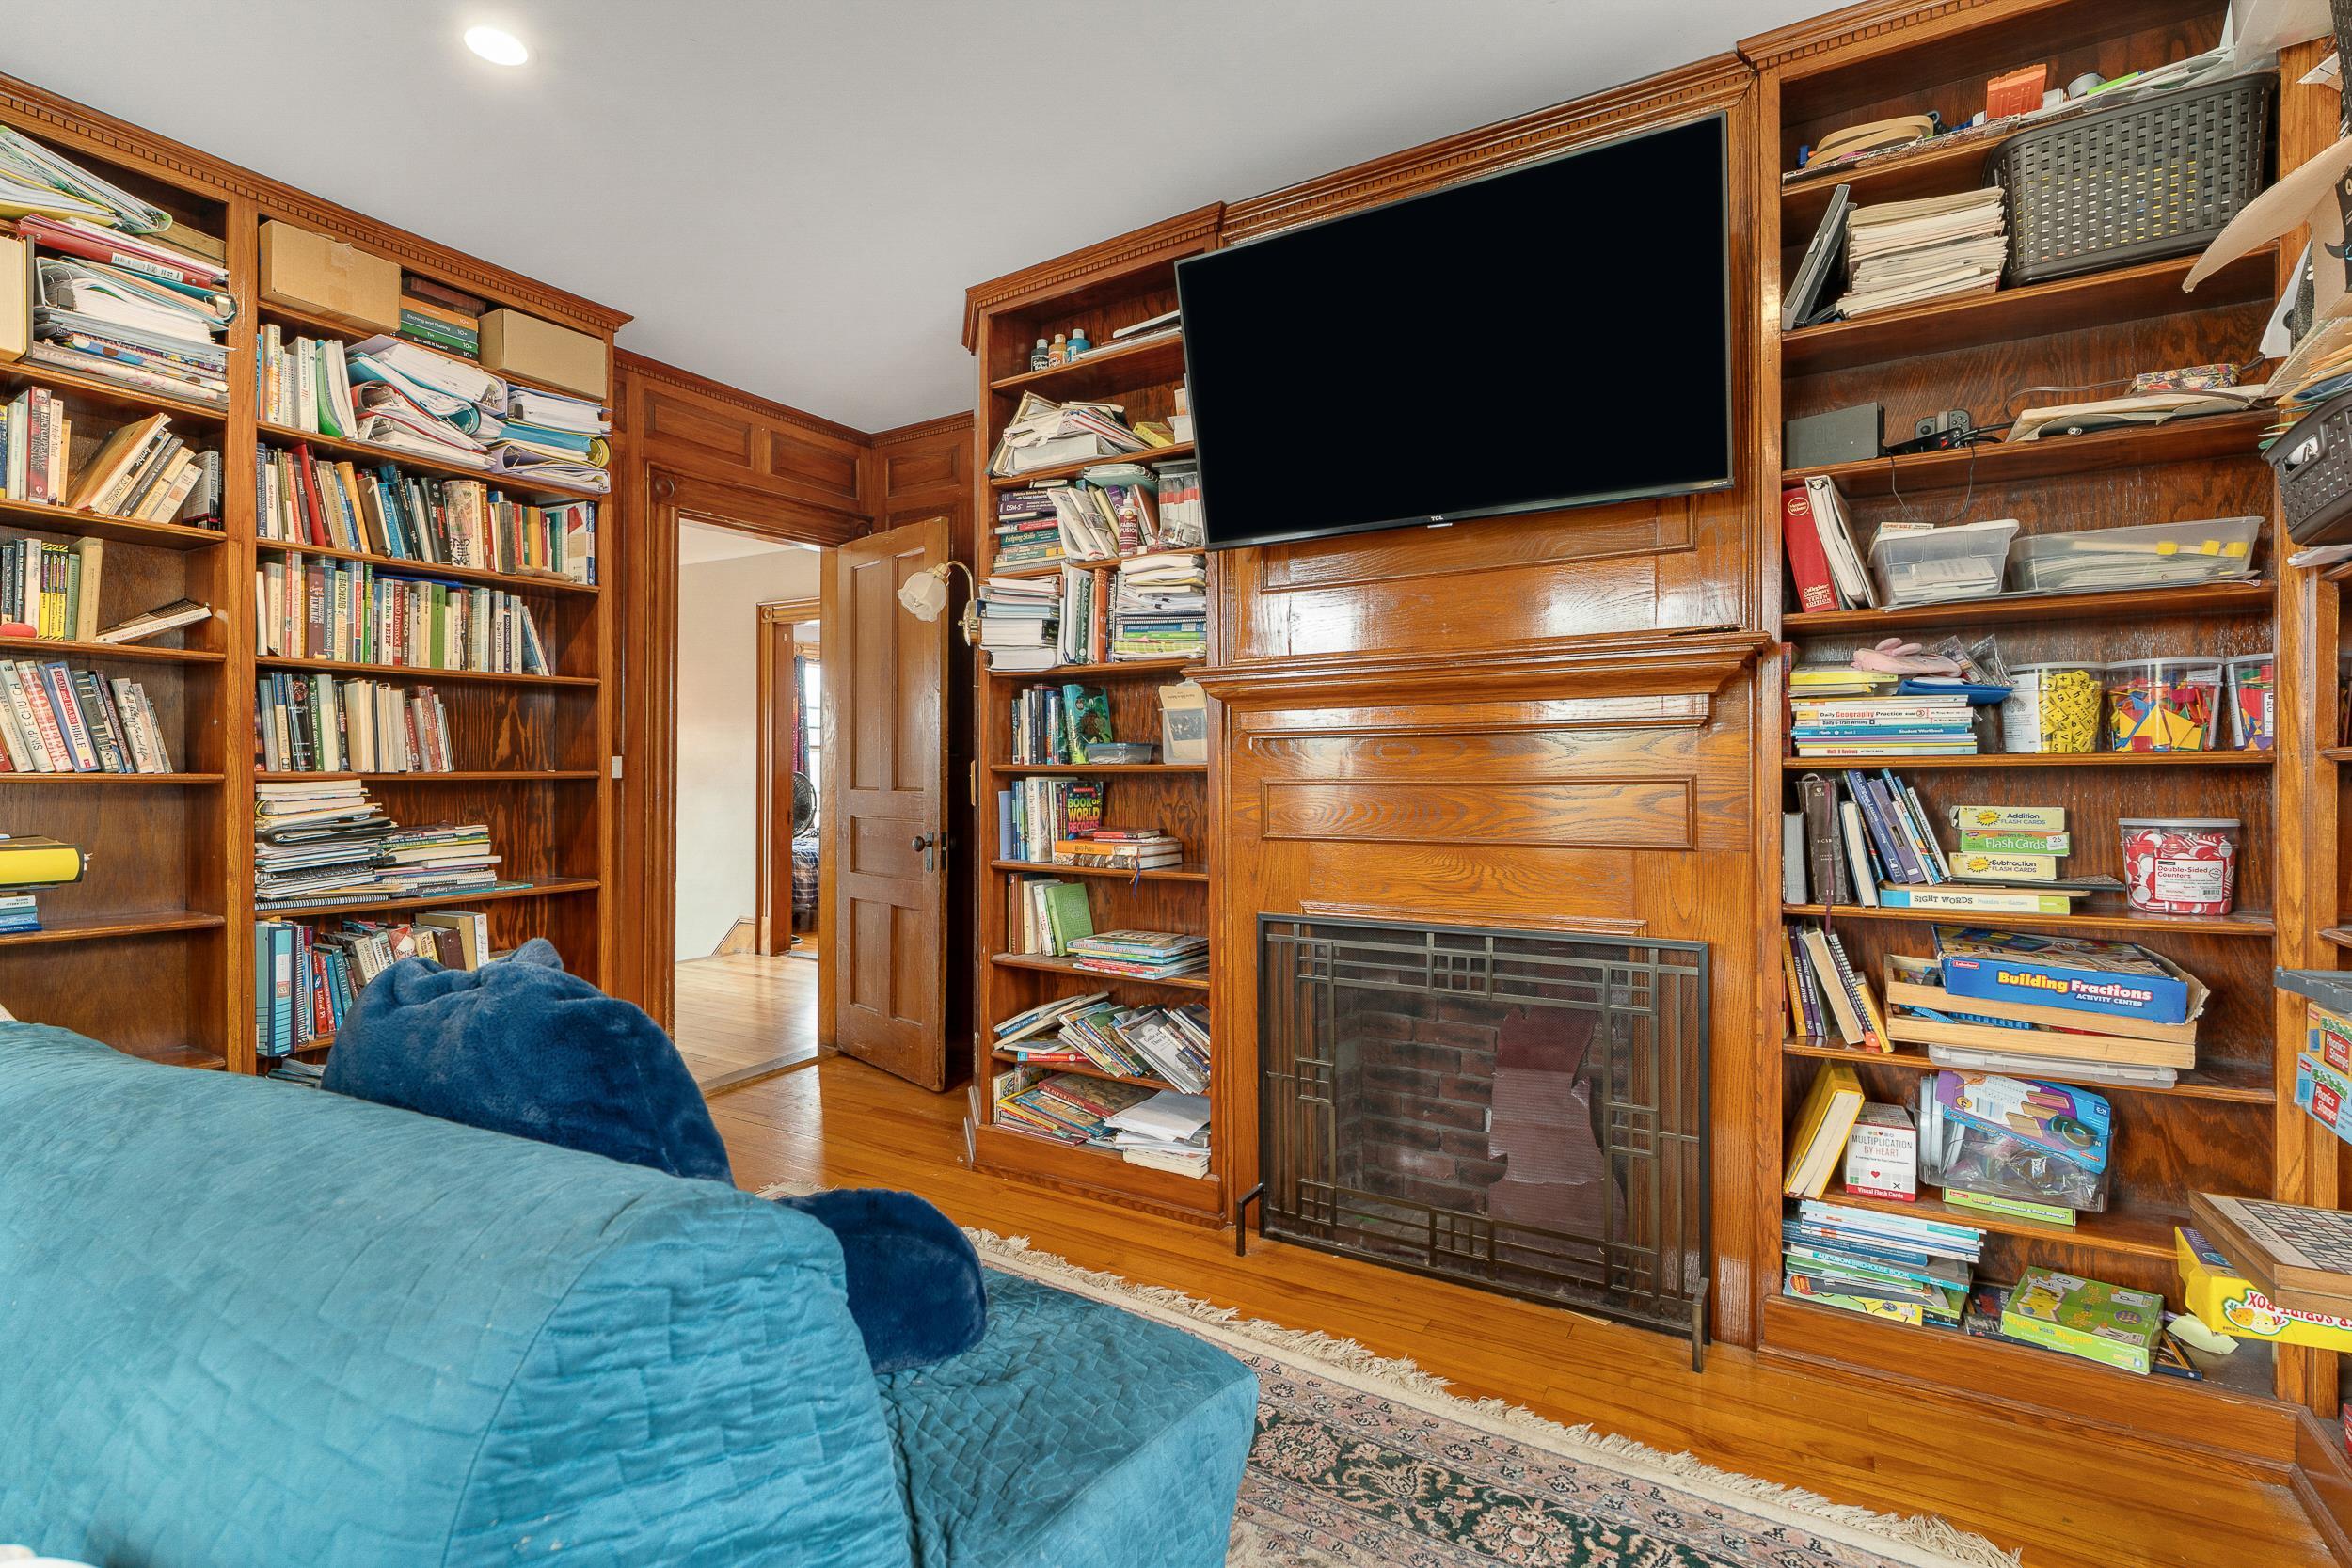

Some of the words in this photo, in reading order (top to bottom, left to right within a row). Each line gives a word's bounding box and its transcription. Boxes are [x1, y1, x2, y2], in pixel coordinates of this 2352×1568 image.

[40, 412, 50, 459] ENCYCLOPEDIA
[31, 438, 40, 469] HISTORY
[51, 440, 59, 458] Meet
[133, 446, 151, 467] Arabic
[210, 453, 218, 470] Nickel
[210, 478, 218, 499] Dimed
[295, 477, 306, 495] preach
[379, 486, 391, 512] Beautiful
[385, 512, 394, 524] Boy
[338, 578, 347, 609] BACKYARD
[1806, 598, 1832, 609] EDITION
[394, 615, 403, 647] LIVESTOCK
[20, 671, 50, 708] 500
[54, 672, 66, 689] READ
[60, 690, 71, 702] and
[64, 701, 77, 724] LEARN
[1836, 710, 1874, 719] Geography
[71, 724, 87, 749] BIBLE
[1067, 798, 1092, 808] BOOK
[1859, 783, 1873, 805] Language
[1866, 801, 1879, 822] Lessons
[1068, 807, 1100, 822] WORLD
[1985, 838, 2014, 849] Flash
[2015, 838, 2045, 850] Cards
[2157, 865, 2208, 874] Double-Sided
[336, 958, 347, 979] STILL
[338, 978, 349, 996] LIFE
[1997, 970, 2069, 993] Building
[2070, 979, 2153, 1001] Fractions
[316, 990, 325, 1002] Life
[2075, 993, 2112, 1003] ACTIVITY
[2113, 997, 2144, 1007] CENTER
[317, 1002, 326, 1011] of
[318, 1010, 326, 1019] Pi
[1851, 1134, 1913, 1149] MULTIPLICATION
[1864, 1146, 1873, 1154] BY
[1875, 1147, 1899, 1158] HEART
[1857, 1186, 1874, 1196] Visual
[1888, 1191, 1904, 1199] Cards
[1817, 1252, 1851, 1265] AUDUBON
[1851, 1256, 1889, 1275] BIRDHOUSE
[1889, 1268, 1911, 1278] BOOK
